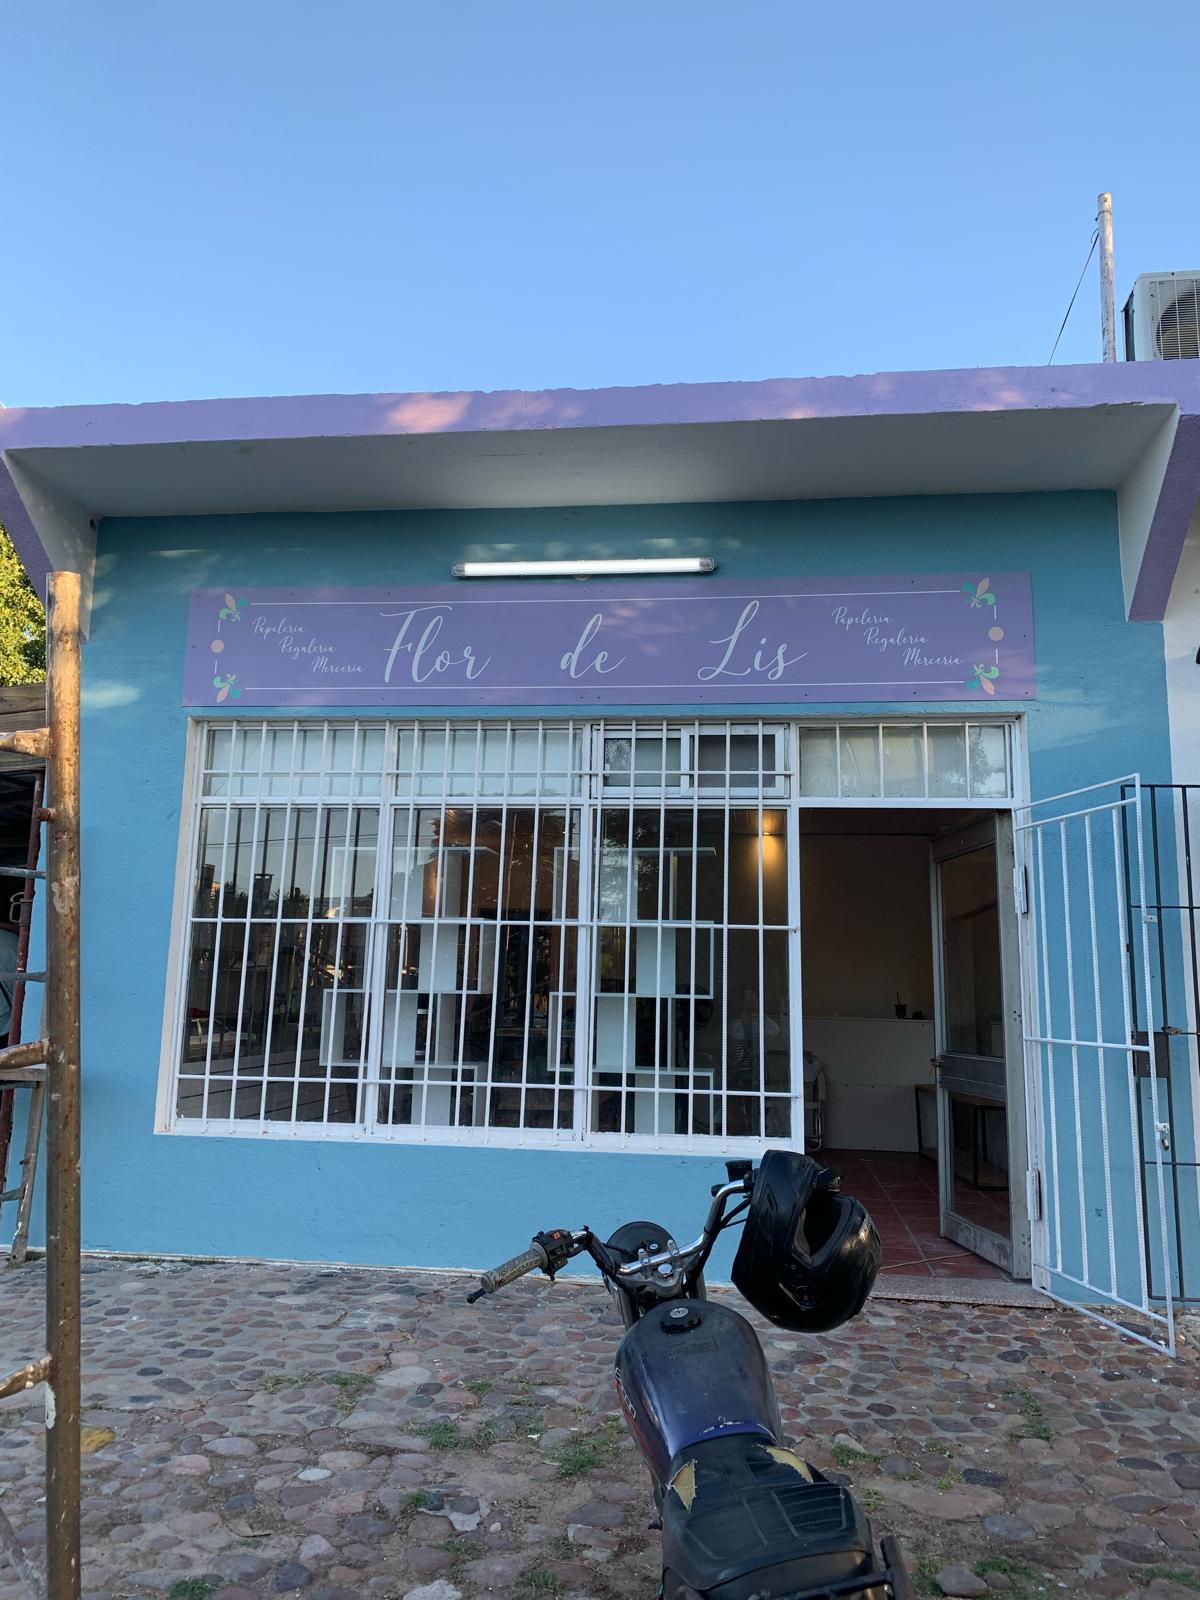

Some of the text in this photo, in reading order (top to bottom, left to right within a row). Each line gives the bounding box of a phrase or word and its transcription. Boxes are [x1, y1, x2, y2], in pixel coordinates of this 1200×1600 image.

[379, 600, 809, 683] Flor de Lis
